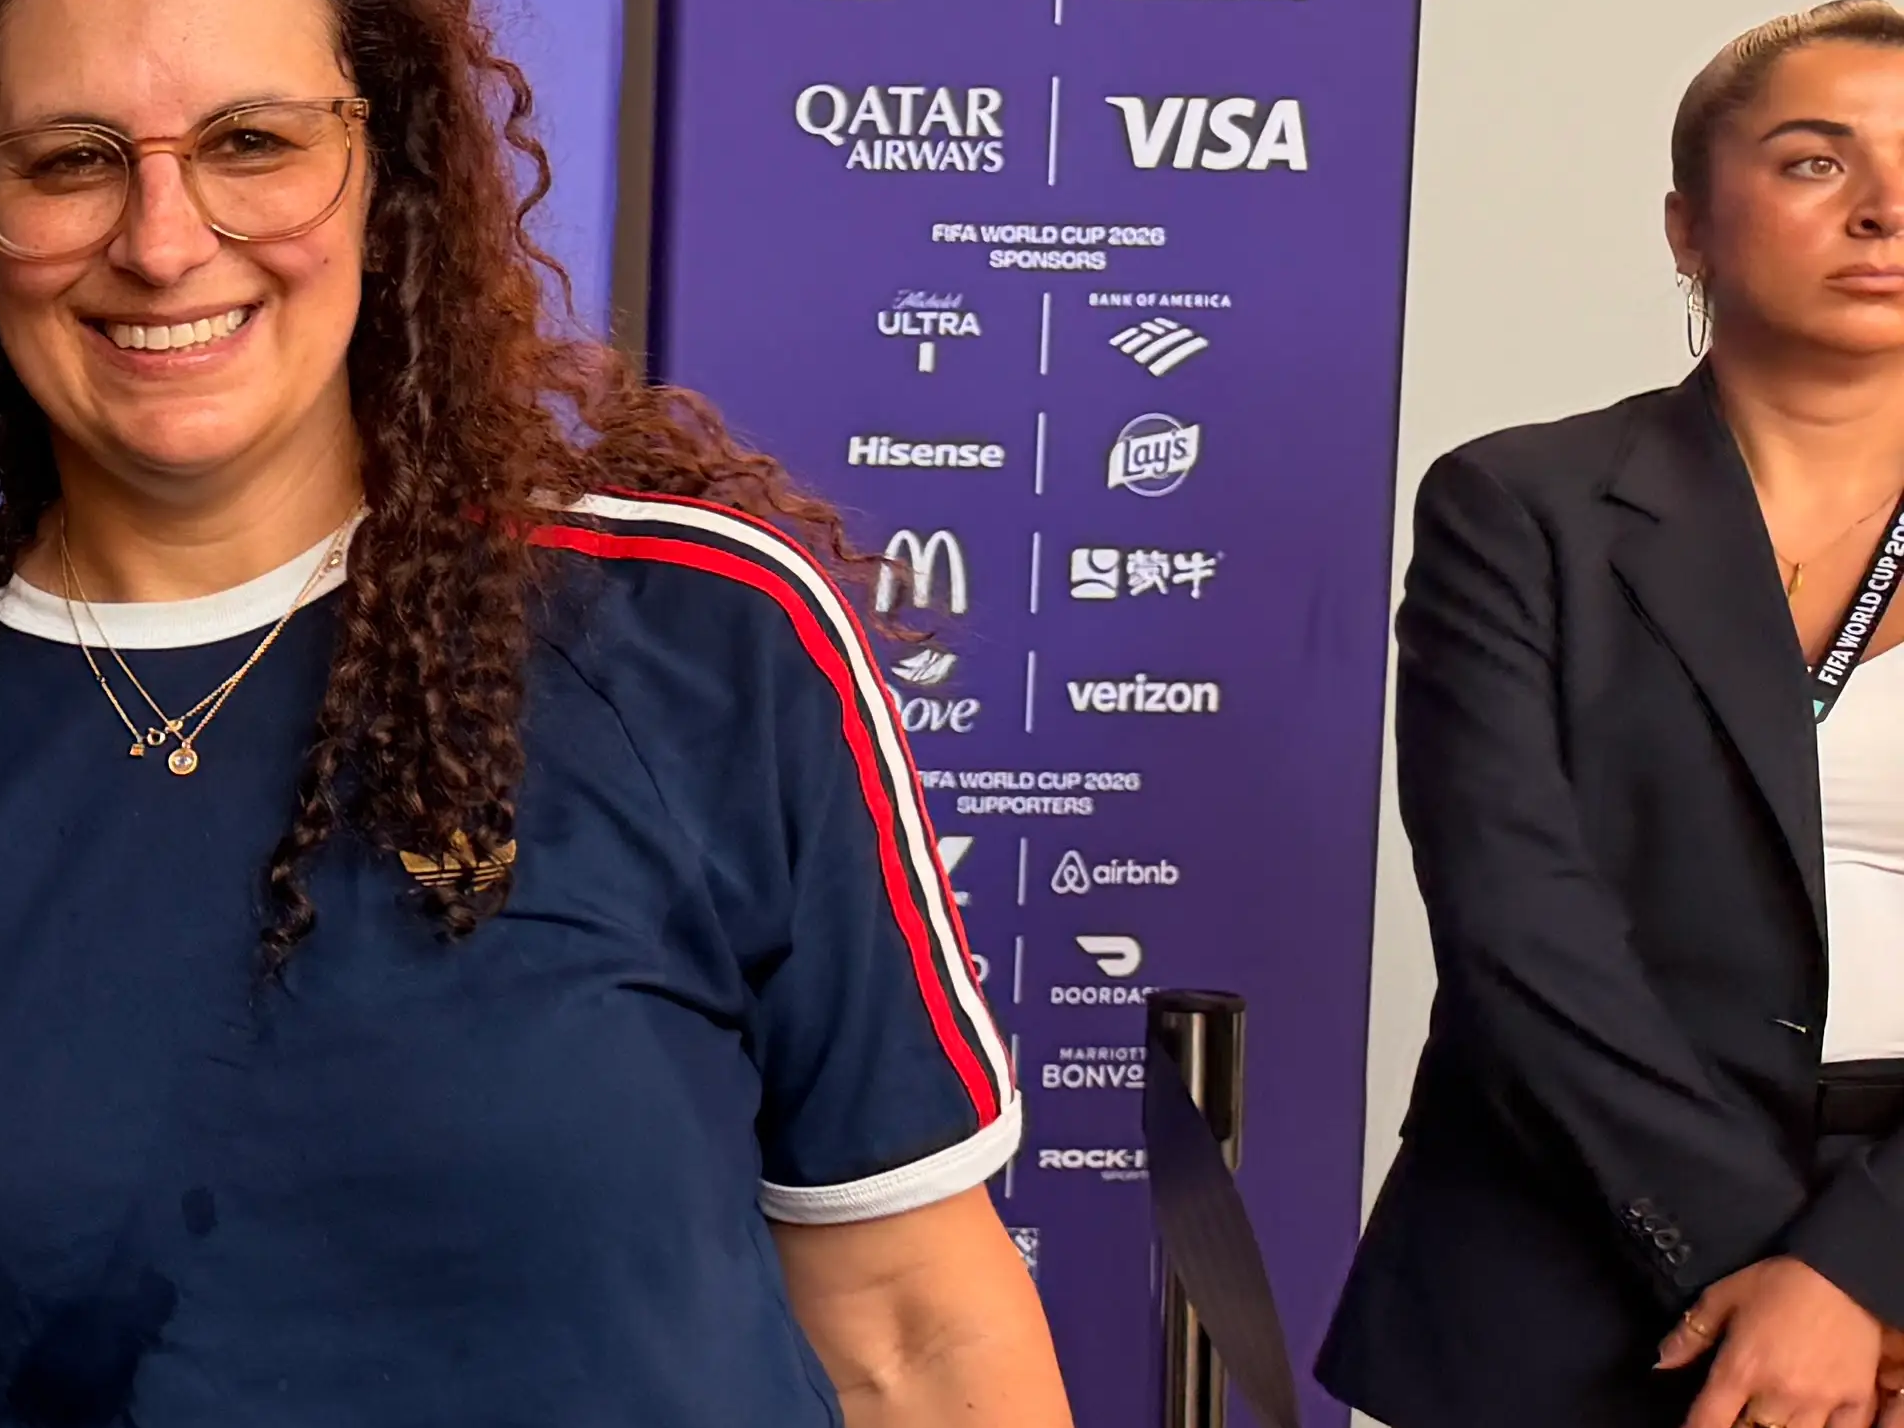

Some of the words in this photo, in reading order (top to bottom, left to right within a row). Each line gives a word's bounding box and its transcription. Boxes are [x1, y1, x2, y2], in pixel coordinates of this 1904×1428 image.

[795, 84, 1003, 147] QATAR
[1105, 96, 1308, 171] VISA
[846, 142, 1003, 172] AIRWAYS
[933, 224, 977, 243] FIFA
[982, 225, 1057, 244] WORLD
[1061, 225, 1105, 245] CUP
[1109, 227, 1164, 246] 2026
[990, 251, 1105, 270] SPONSORS
[1089, 292, 1133, 306] BANK
[1136, 293, 1156, 307] OF
[1158, 293, 1232, 308] AMERICA
[878, 312, 981, 336] ULTRA
[848, 436, 1004, 468] Hisense
[1127, 549, 1216, 598] 蒙牛
[1818, 649, 1853, 686] FIFA
[1836, 591, 1882, 648] WORLD
[1868, 555, 1898, 590] CUP
[1067, 673, 1219, 713] verizon
[960, 771, 1033, 789] WORLD
[1038, 772, 1080, 790] CUP
[1084, 772, 1140, 791] 2026
[957, 796, 1094, 815] SUPPORTERS
[1093, 859, 1179, 886] airbnb
[1051, 986, 1159, 1004] DOORDAS
[1059, 1047, 1147, 1061] MARRIOTT
[1042, 1064, 1145, 1088] BONVO
[1038, 1149, 1147, 1169] ROCK-I
